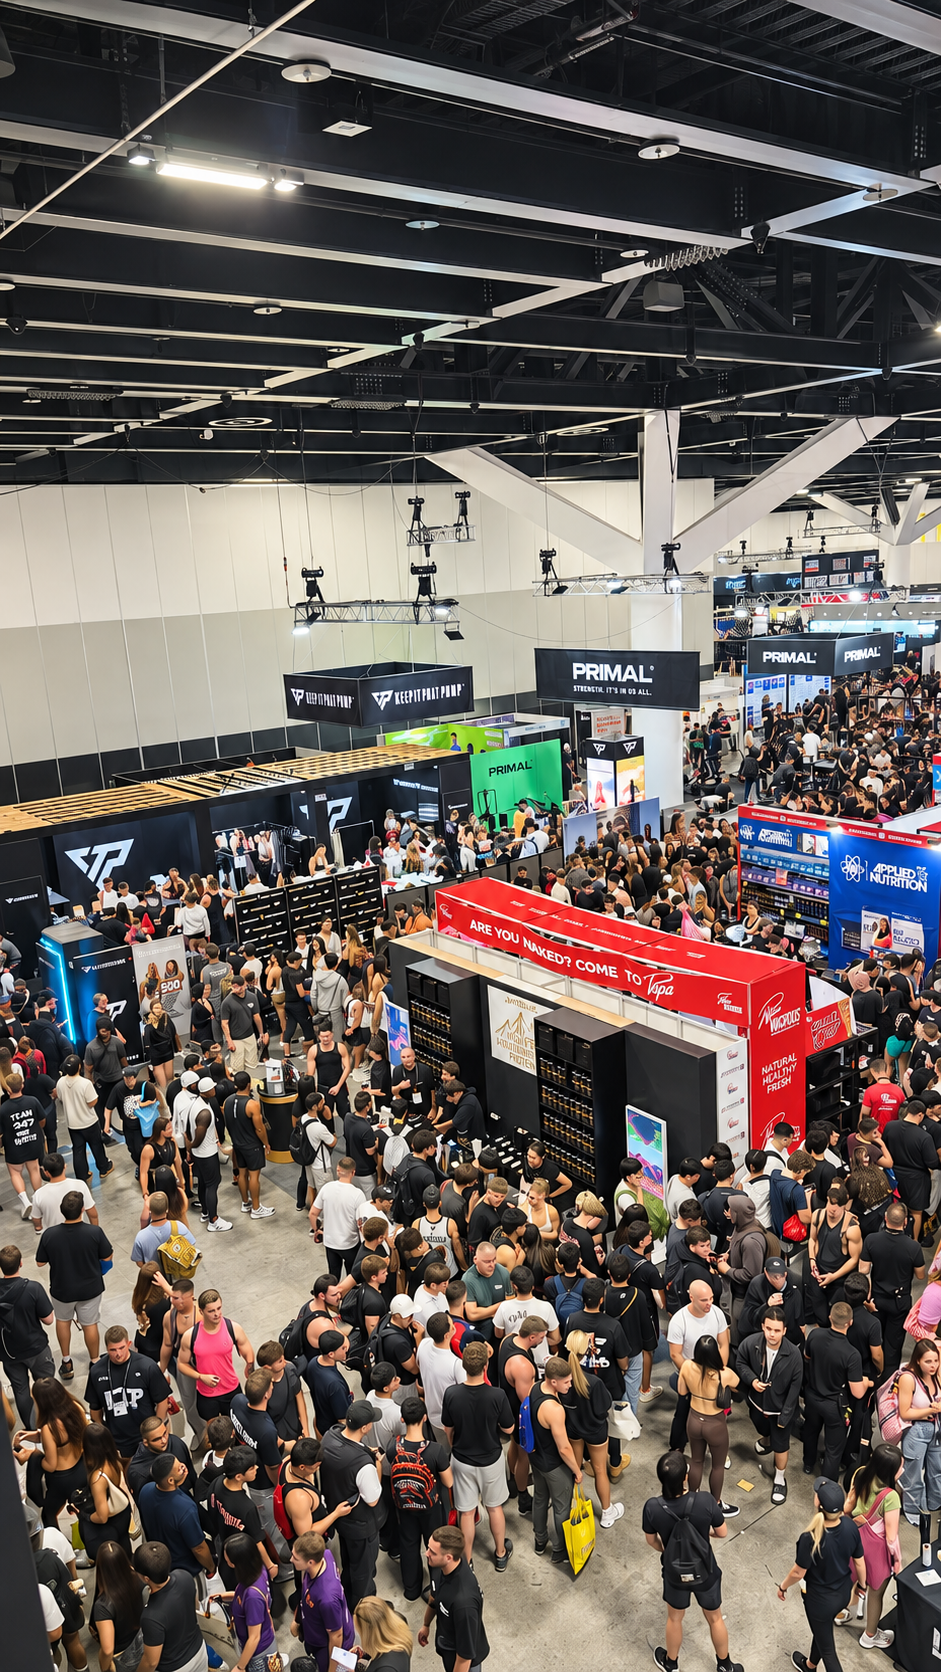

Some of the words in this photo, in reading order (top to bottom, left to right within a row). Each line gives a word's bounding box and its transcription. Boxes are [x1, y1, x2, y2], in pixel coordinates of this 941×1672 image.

[763, 652, 816, 663] PRIMAL
[844, 647, 880, 662] PRIMAL
[573, 662, 653, 683] PRIMAL
[489, 761, 533, 777] PRIMAL
[873, 863, 916, 880] APPLIED
[870, 872, 928, 893] NUTRITION
[470, 919, 493, 936] ARE
[494, 927, 520, 943] YOU
[523, 936, 571, 967] NAKED?
[575, 959, 619, 978] COME
[624, 969, 642, 986] TO
[761, 1053, 798, 1075] NATURAL
[762, 1062, 798, 1086] HEALTHY
[767, 1075, 792, 1094] FRESH
